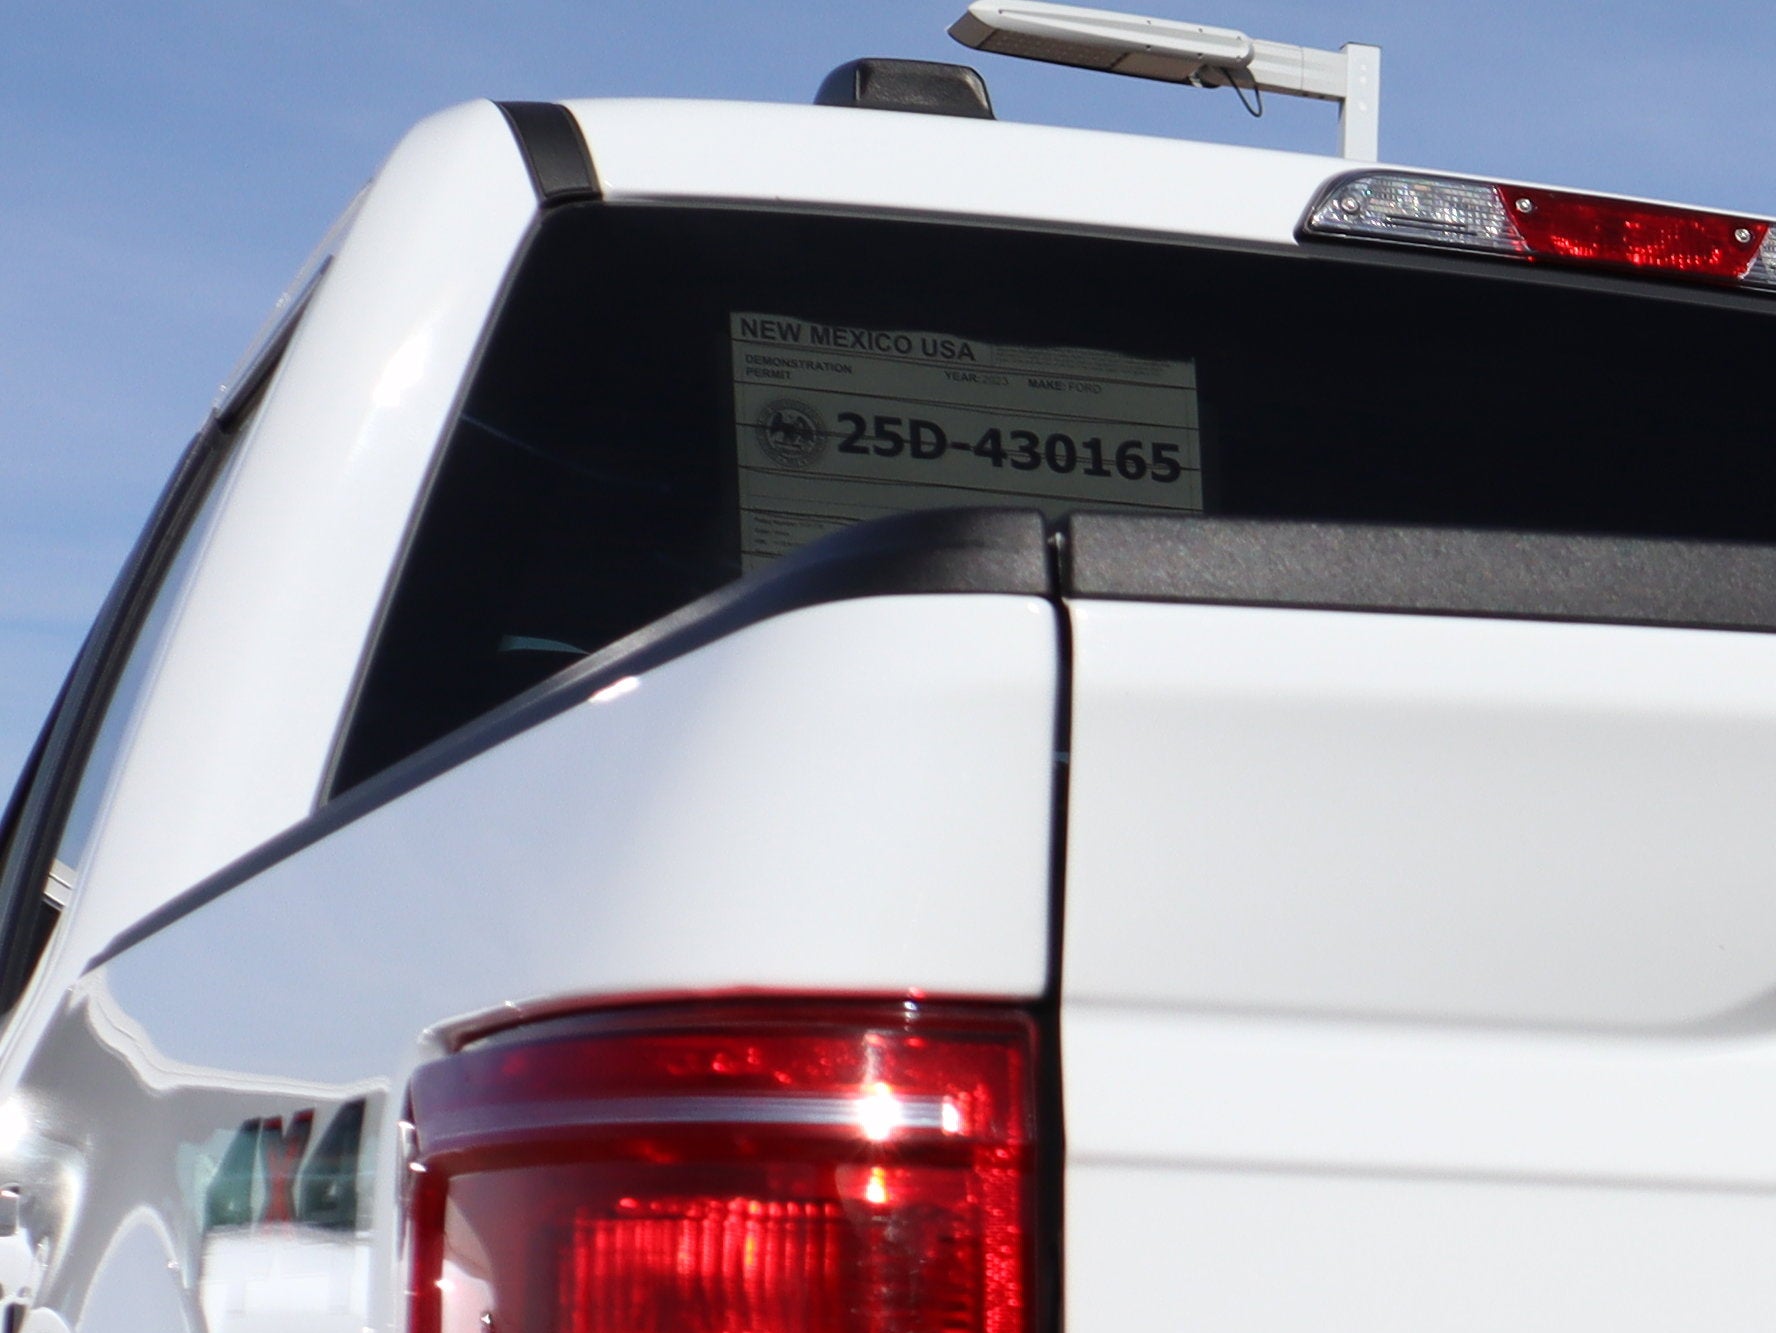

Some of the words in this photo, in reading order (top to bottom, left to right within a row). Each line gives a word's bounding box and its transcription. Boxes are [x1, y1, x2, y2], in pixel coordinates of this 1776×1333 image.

[740, 317, 801, 343] NEW
[810, 324, 912, 355] MEXICO
[921, 337, 976, 362] USA
[745, 354, 853, 374] DEMONSTRATION
[745, 367, 791, 380] PERMIT
[1068, 381, 1102, 394] FORD
[836, 411, 1183, 484] 25D-430165
